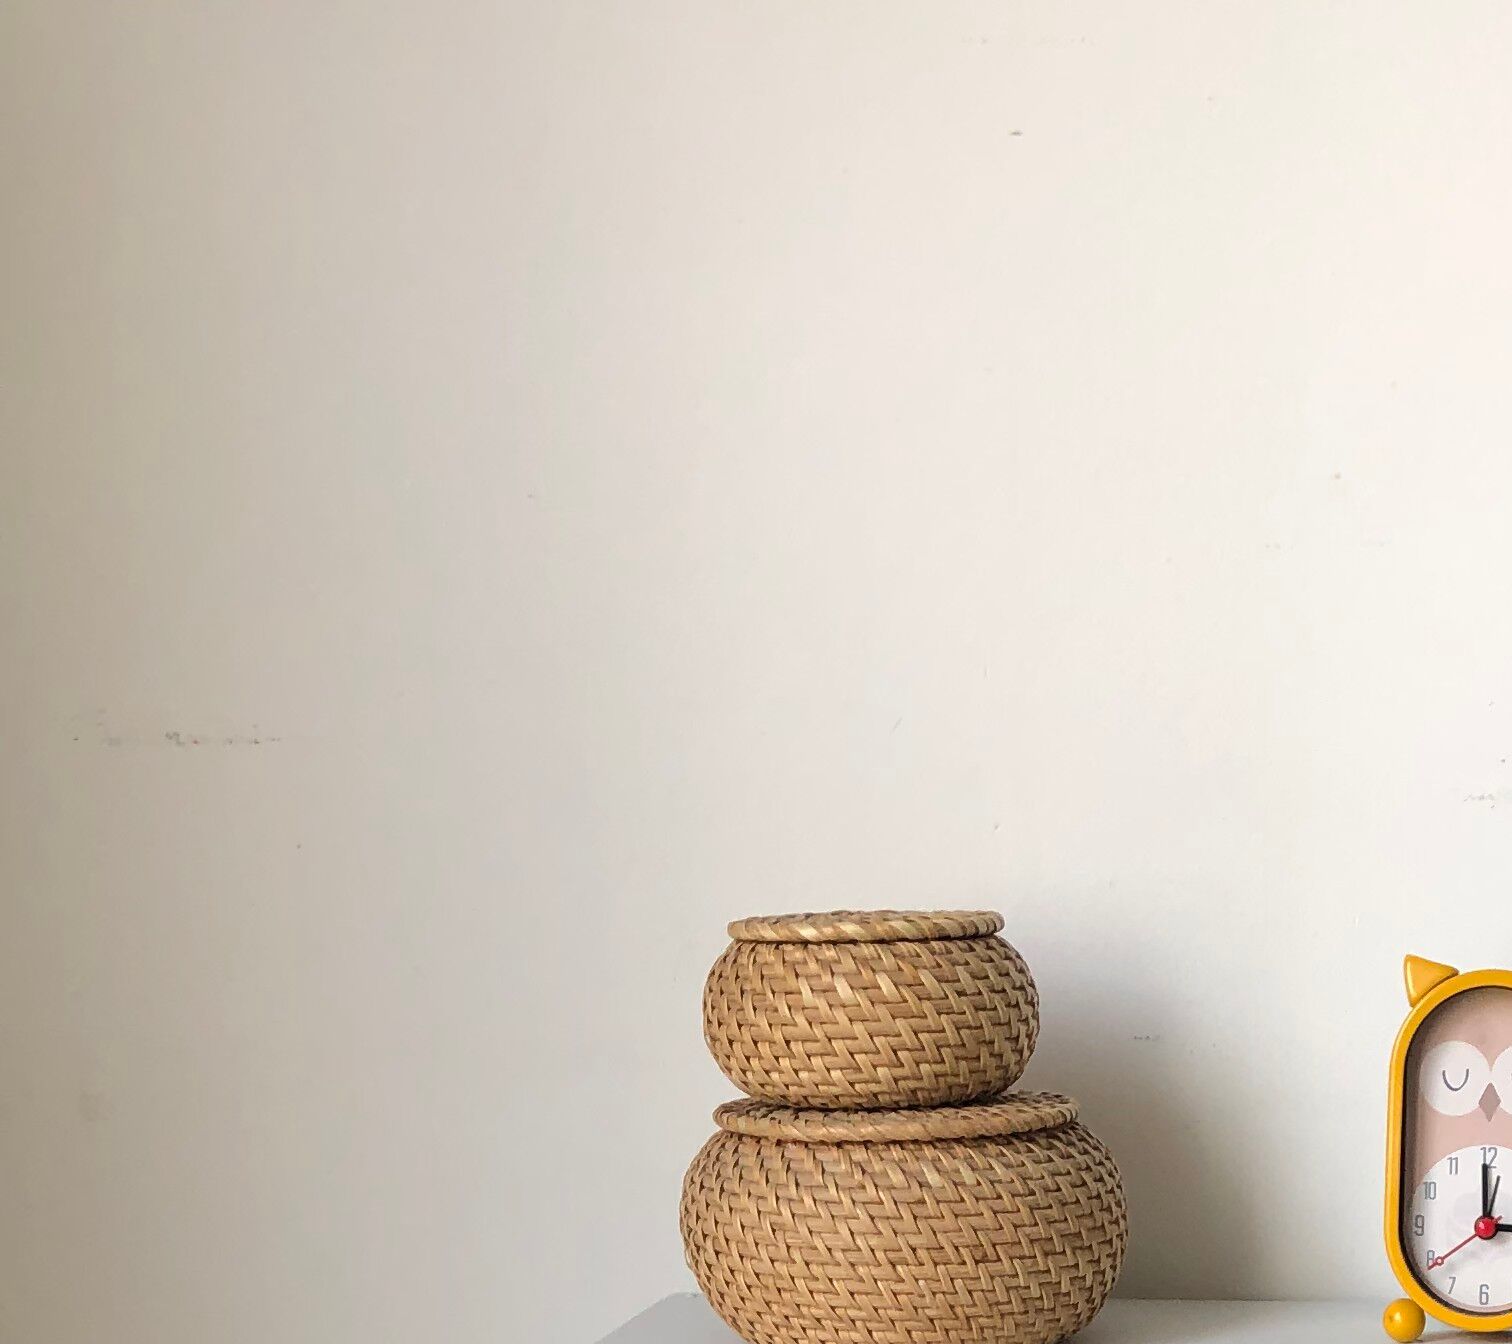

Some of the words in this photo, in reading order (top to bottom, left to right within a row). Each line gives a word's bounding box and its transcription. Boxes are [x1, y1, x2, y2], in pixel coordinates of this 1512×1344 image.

[1447, 1157, 1459, 1175] 11
[1480, 1147, 1498, 1168] 12
[1423, 1181, 1437, 1200] 10
[1414, 1214, 1425, 1236] 9
[1448, 1276, 1457, 1295] 7
[1479, 1284, 1490, 1306] 6
